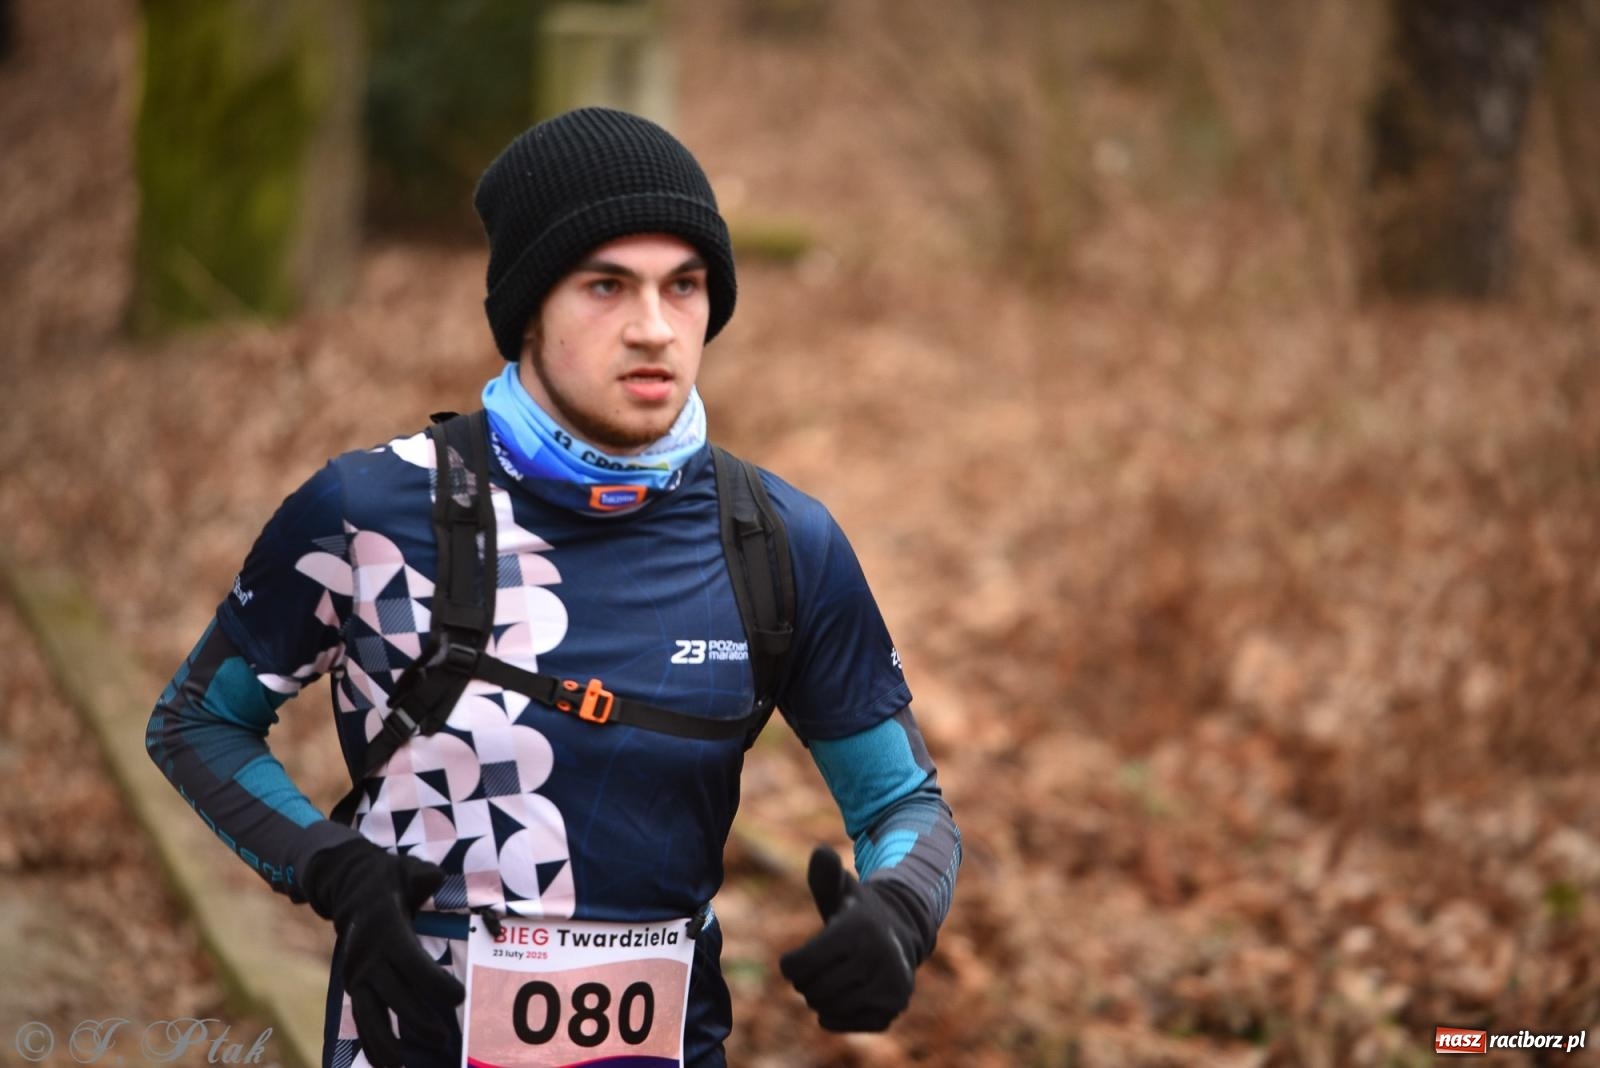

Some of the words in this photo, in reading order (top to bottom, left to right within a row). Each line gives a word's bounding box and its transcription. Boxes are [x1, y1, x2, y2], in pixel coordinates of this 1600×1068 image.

[670, 640, 707, 664] 23
[493, 926, 549, 946] BIEG
[557, 926, 679, 948] Twardziela
[492, 948, 504, 957] 23
[505, 950, 524, 961] luty
[526, 951, 548, 960] 2025
[512, 980, 655, 1048] 080
